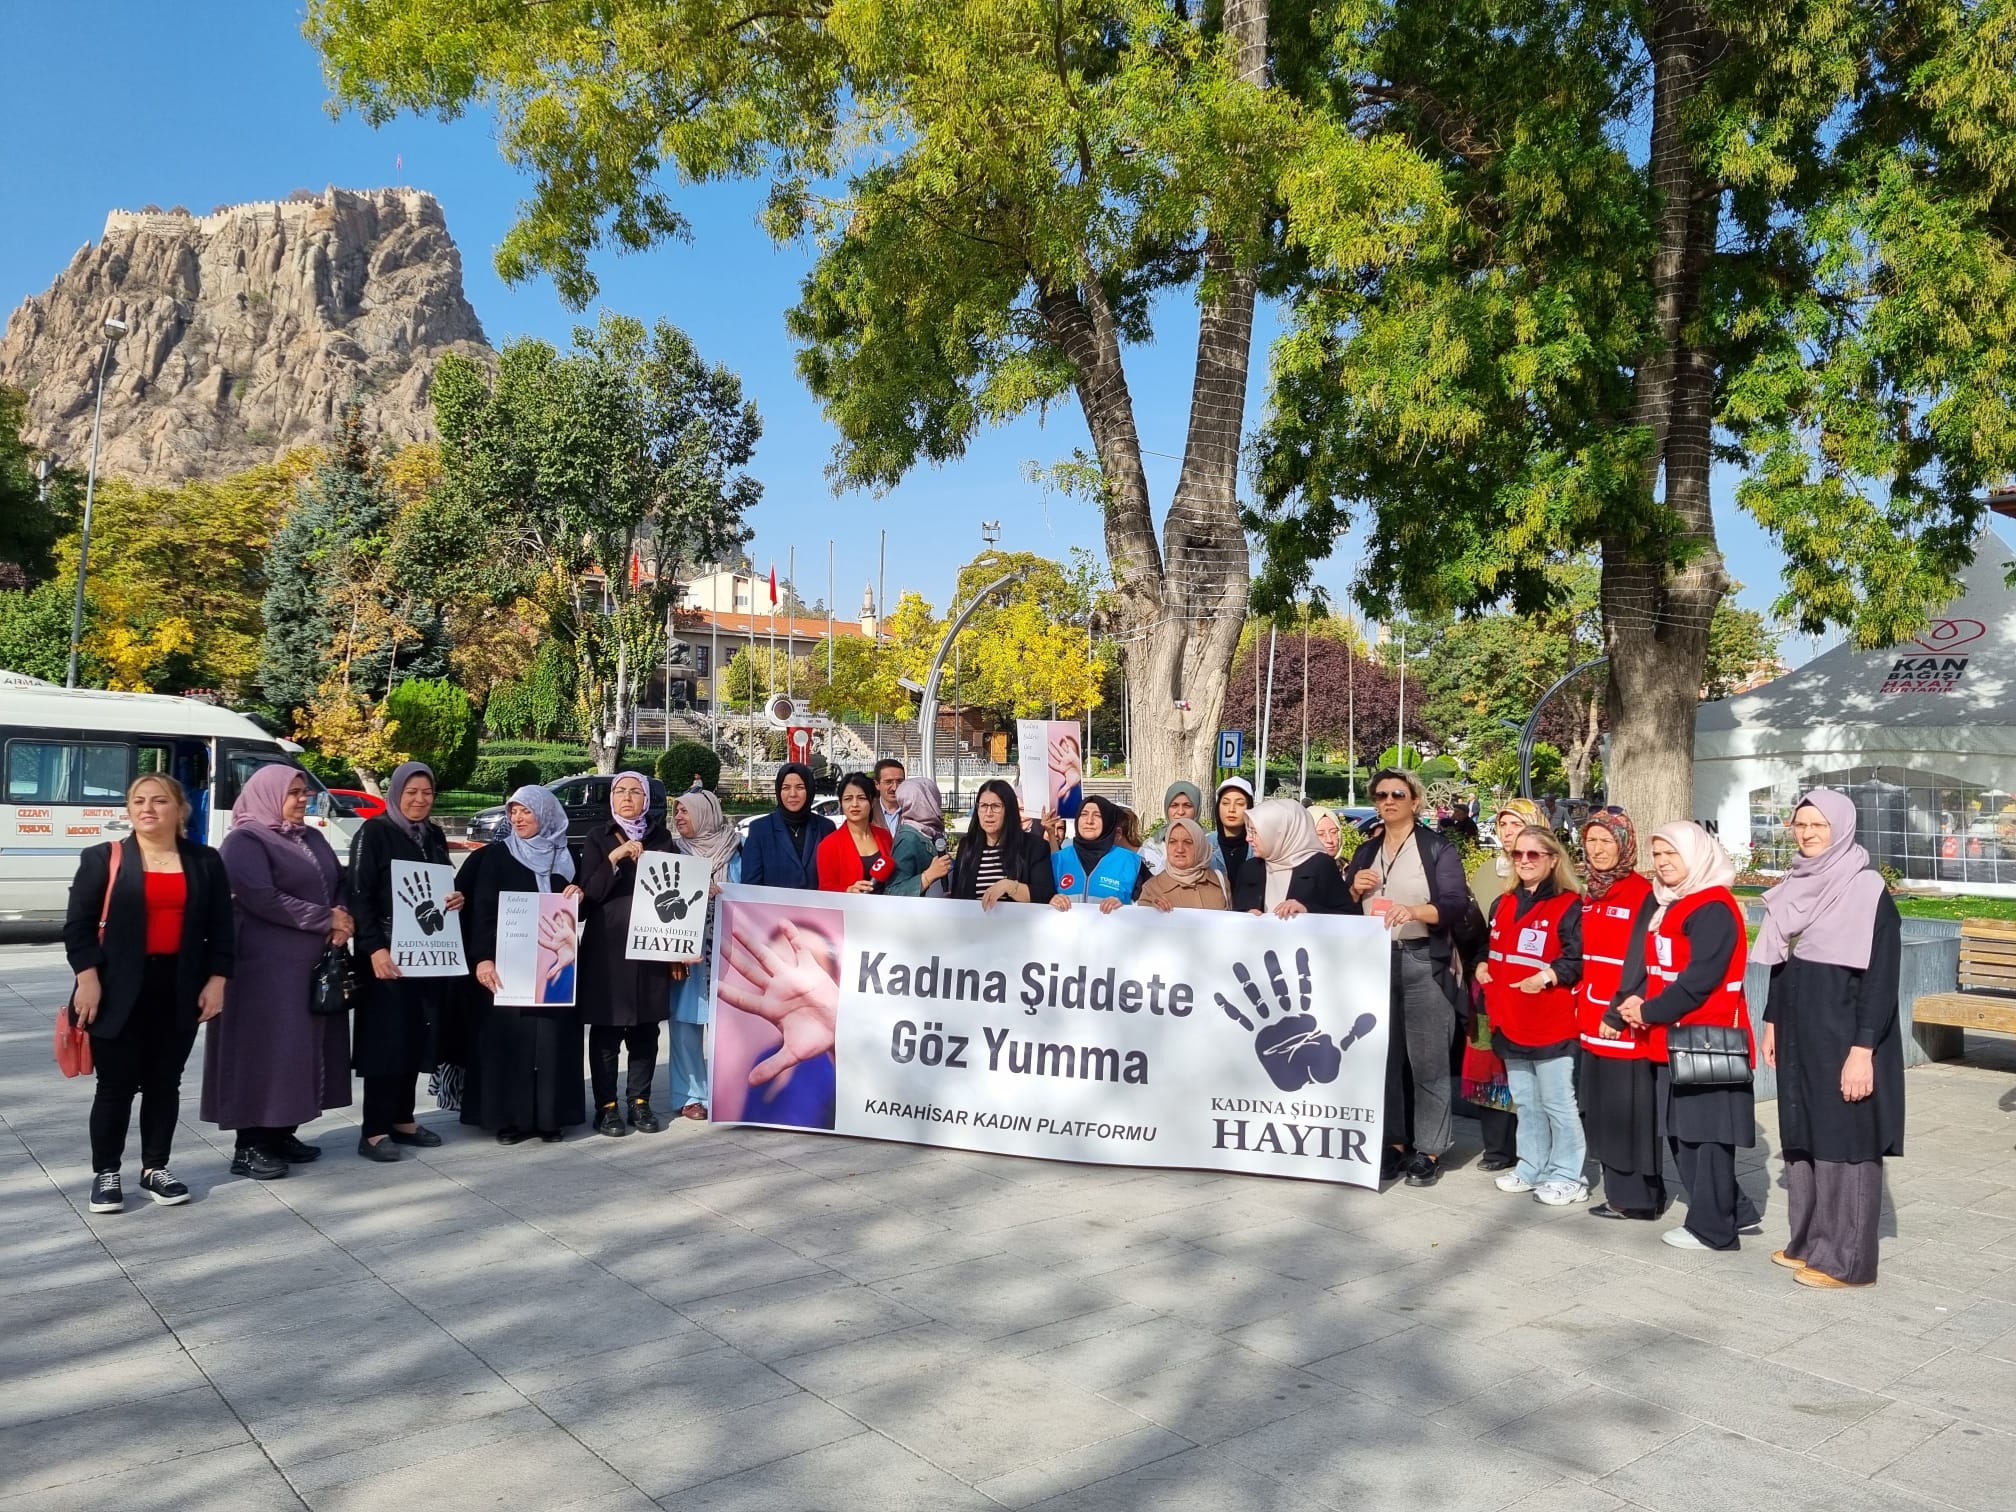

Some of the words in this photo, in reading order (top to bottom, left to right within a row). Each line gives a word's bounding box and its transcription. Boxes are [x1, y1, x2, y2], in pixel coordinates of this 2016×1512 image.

[1892, 658, 1969, 671] KAN
[1887, 670, 1963, 680] BAĞIŞI
[1882, 680, 1958, 688] HAYAT
[1225, 740, 1235, 758] D
[872, 858, 886, 871] 3
[633, 925, 663, 934] KADINA
[665, 927, 698, 937] ŞİDDETE
[397, 940, 429, 948] KADINA
[430, 940, 458, 949] ŞİDDETE
[632, 935, 696, 954] HAYIR
[397, 950, 460, 966] HAYIR
[858, 951, 1006, 1003] Kadına
[1020, 962, 1193, 1017] Şiddete
[891, 1020, 969, 1068] Göz
[983, 1027, 1148, 1084] Yumma
[1211, 1097, 1286, 1115] KADINA
[1290, 1100, 1375, 1123] ŞİDDETE
[864, 1099, 969, 1125] KARAHİSAR
[973, 1112, 1031, 1132] KADIN
[1037, 1119, 1157, 1142] PLATFORMU
[1212, 1118, 1372, 1165] HAYIR
